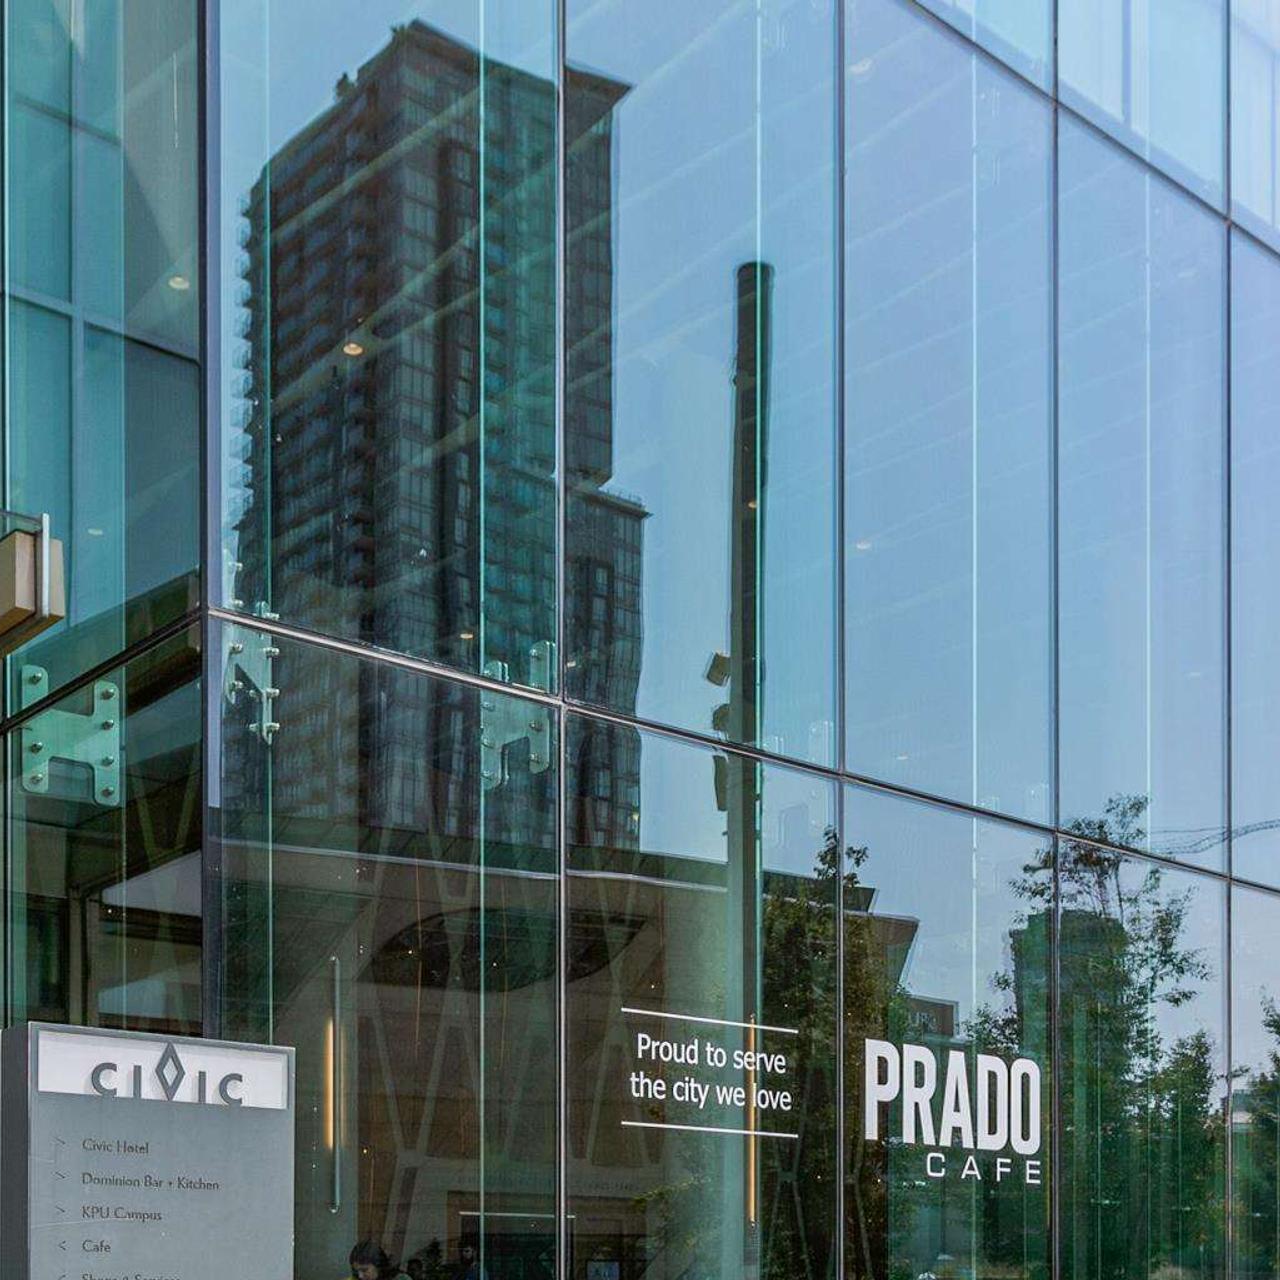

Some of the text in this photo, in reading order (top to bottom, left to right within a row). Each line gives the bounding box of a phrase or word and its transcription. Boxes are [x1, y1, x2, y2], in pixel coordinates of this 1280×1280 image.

[637, 1032, 786, 1073] Proud to serve
[630, 1071, 792, 1111] the city we love
[864, 1038, 1042, 1156] PRADO
[82, 1138, 149, 1154] Civic Hotel
[82, 1172, 140, 1188] Dominion
[143, 1174, 163, 1189] Bar
[177, 1176, 220, 1191] Kitchen
[926, 1152, 1041, 1184] CAFE
[82, 1206, 162, 1222] KPU Campus
